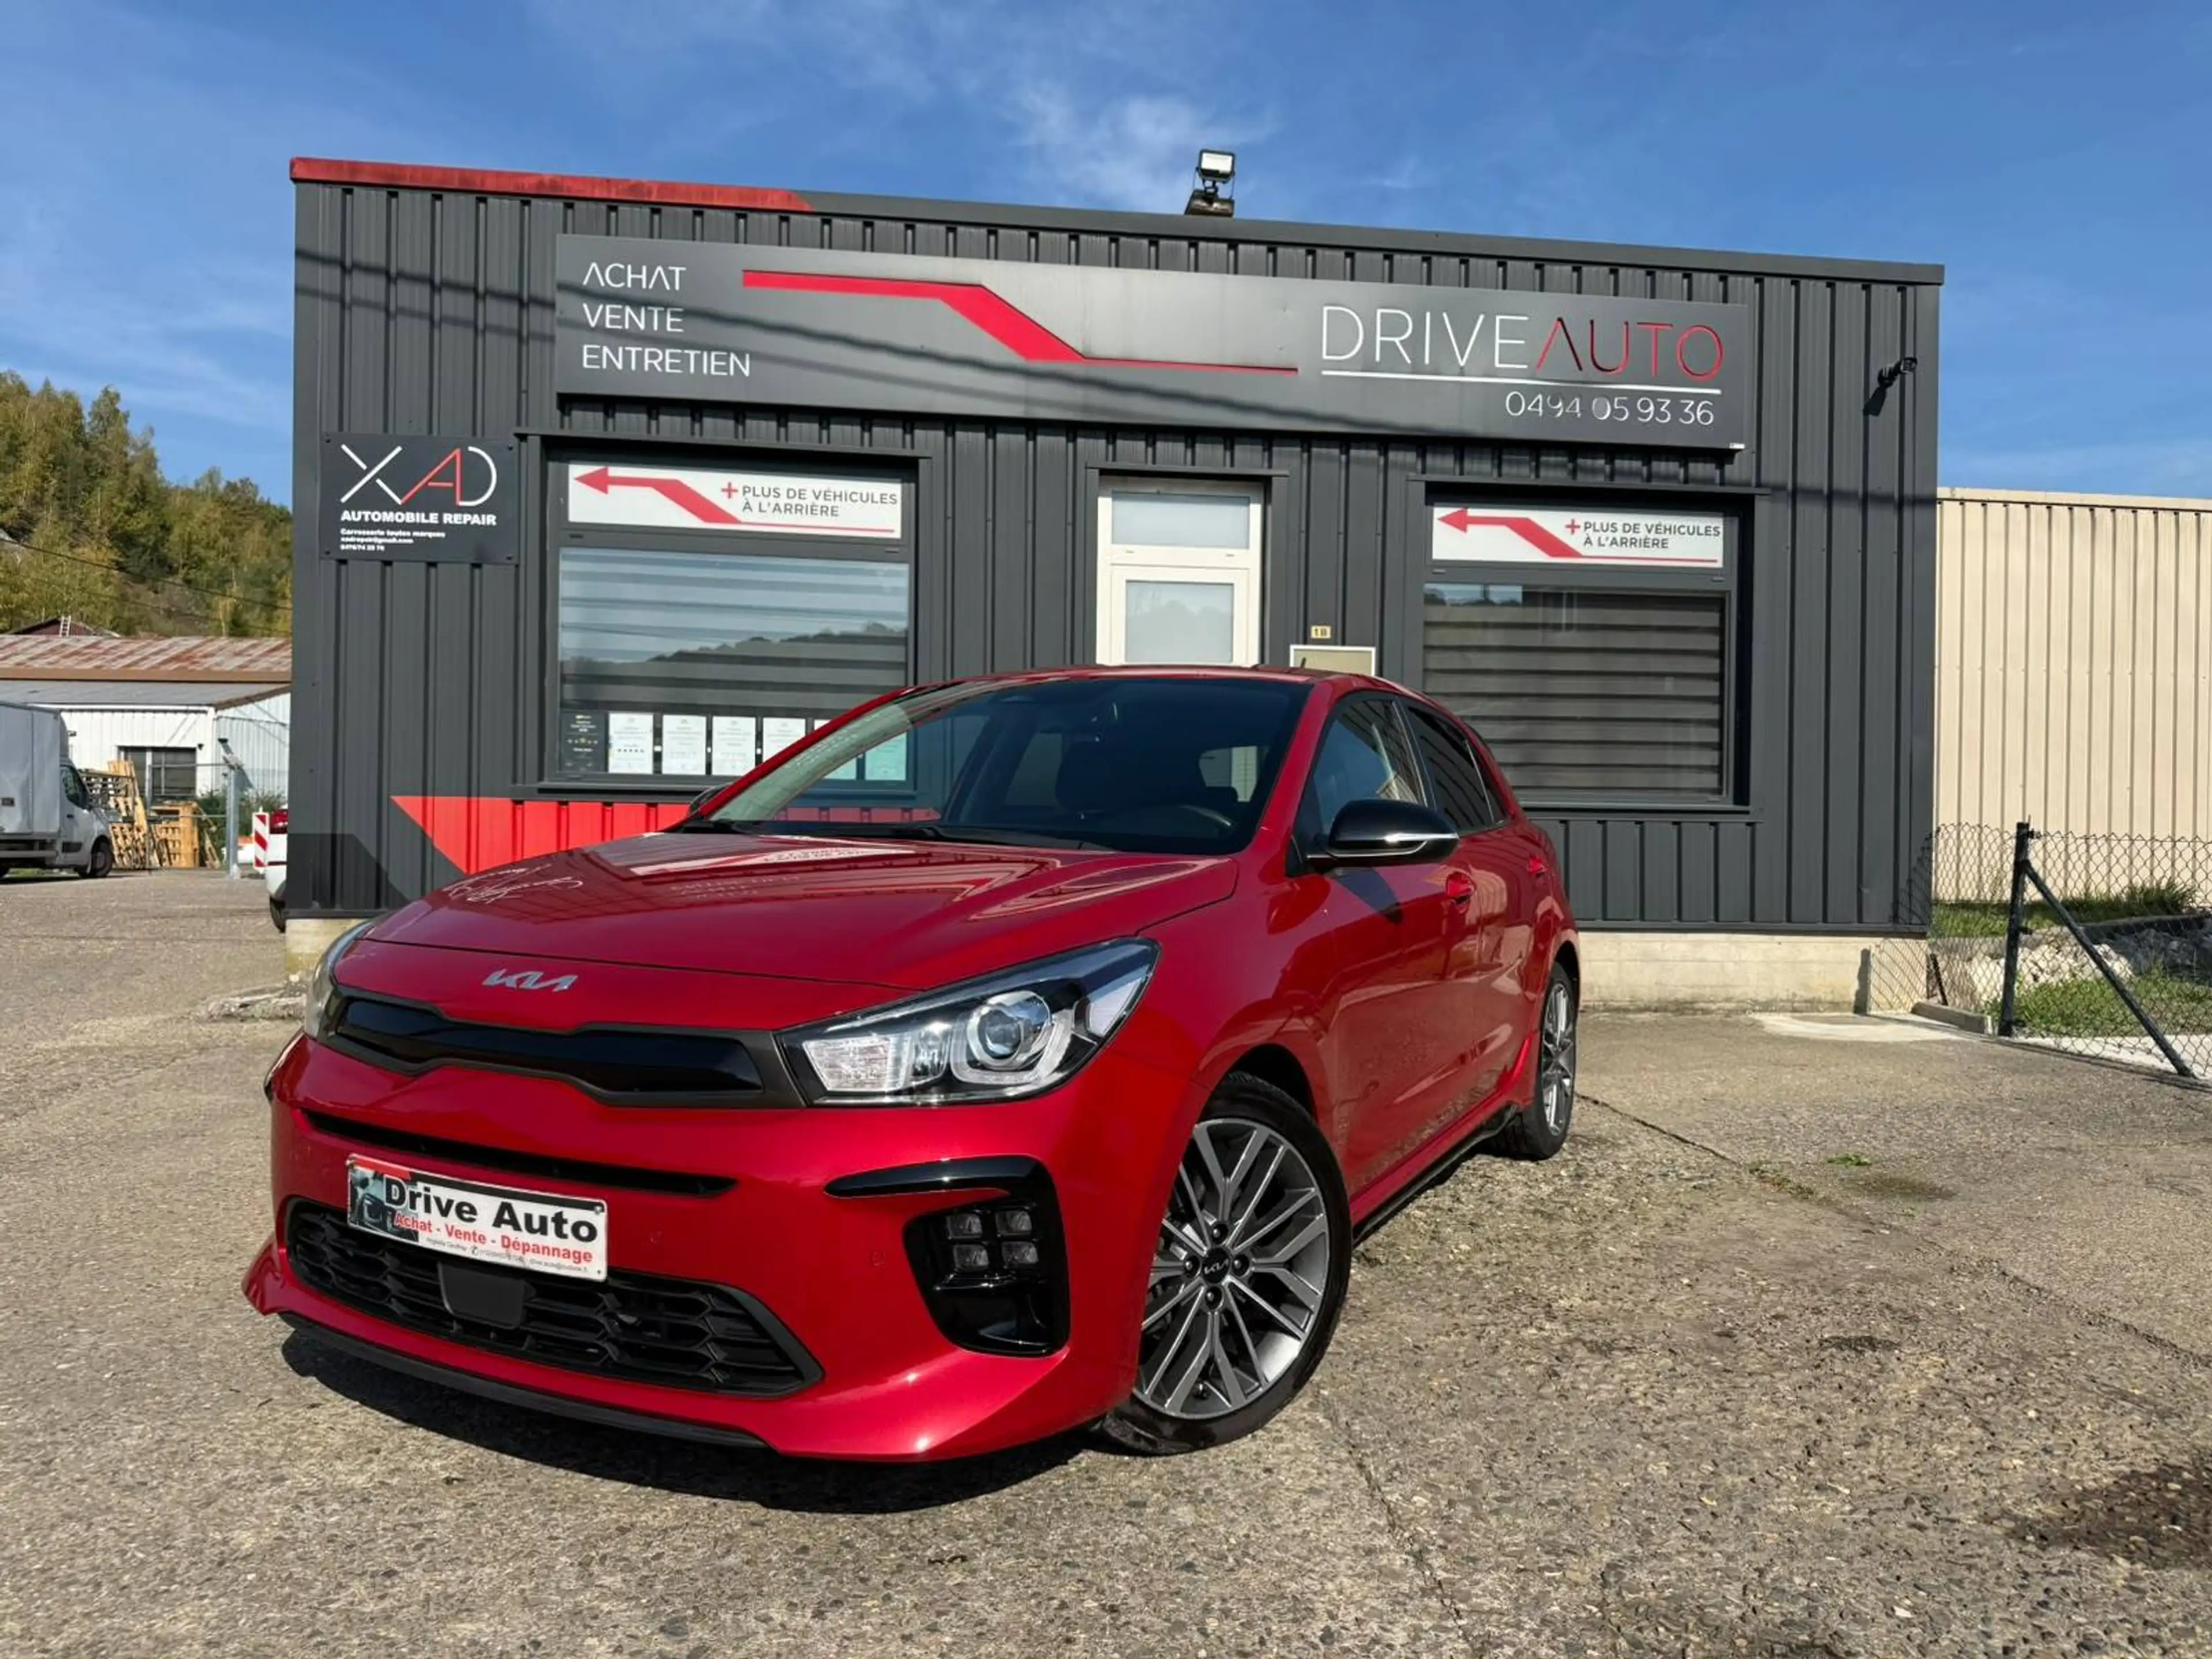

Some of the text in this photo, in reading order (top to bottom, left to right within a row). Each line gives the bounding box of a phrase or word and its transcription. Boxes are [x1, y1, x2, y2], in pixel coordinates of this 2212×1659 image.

[582, 262, 686, 291] ACHAT
[582, 302, 684, 332] VENTE
[582, 344, 749, 377] ENTRETIEN
[1505, 391, 1714, 426] 0494 05 93 36
[340, 444, 497, 507] XAD
[742, 499, 839, 517] À L'ARRIÈRE
[743, 485, 897, 505] PLUS DE VÉHICULES
[340, 510, 497, 526] AUTOMOBILE REPAIR
[1584, 521, 1721, 537] PLUS DE VÉHICULES
[1583, 534, 1669, 549] À L'ARRIÈRE
[481, 968, 579, 993] KIA
[383, 1174, 599, 1243] Drive Auto
[395, 1212, 433, 1234] Achat
[445, 1224, 487, 1244] Vente
[500, 1234, 593, 1264] Dépannage
